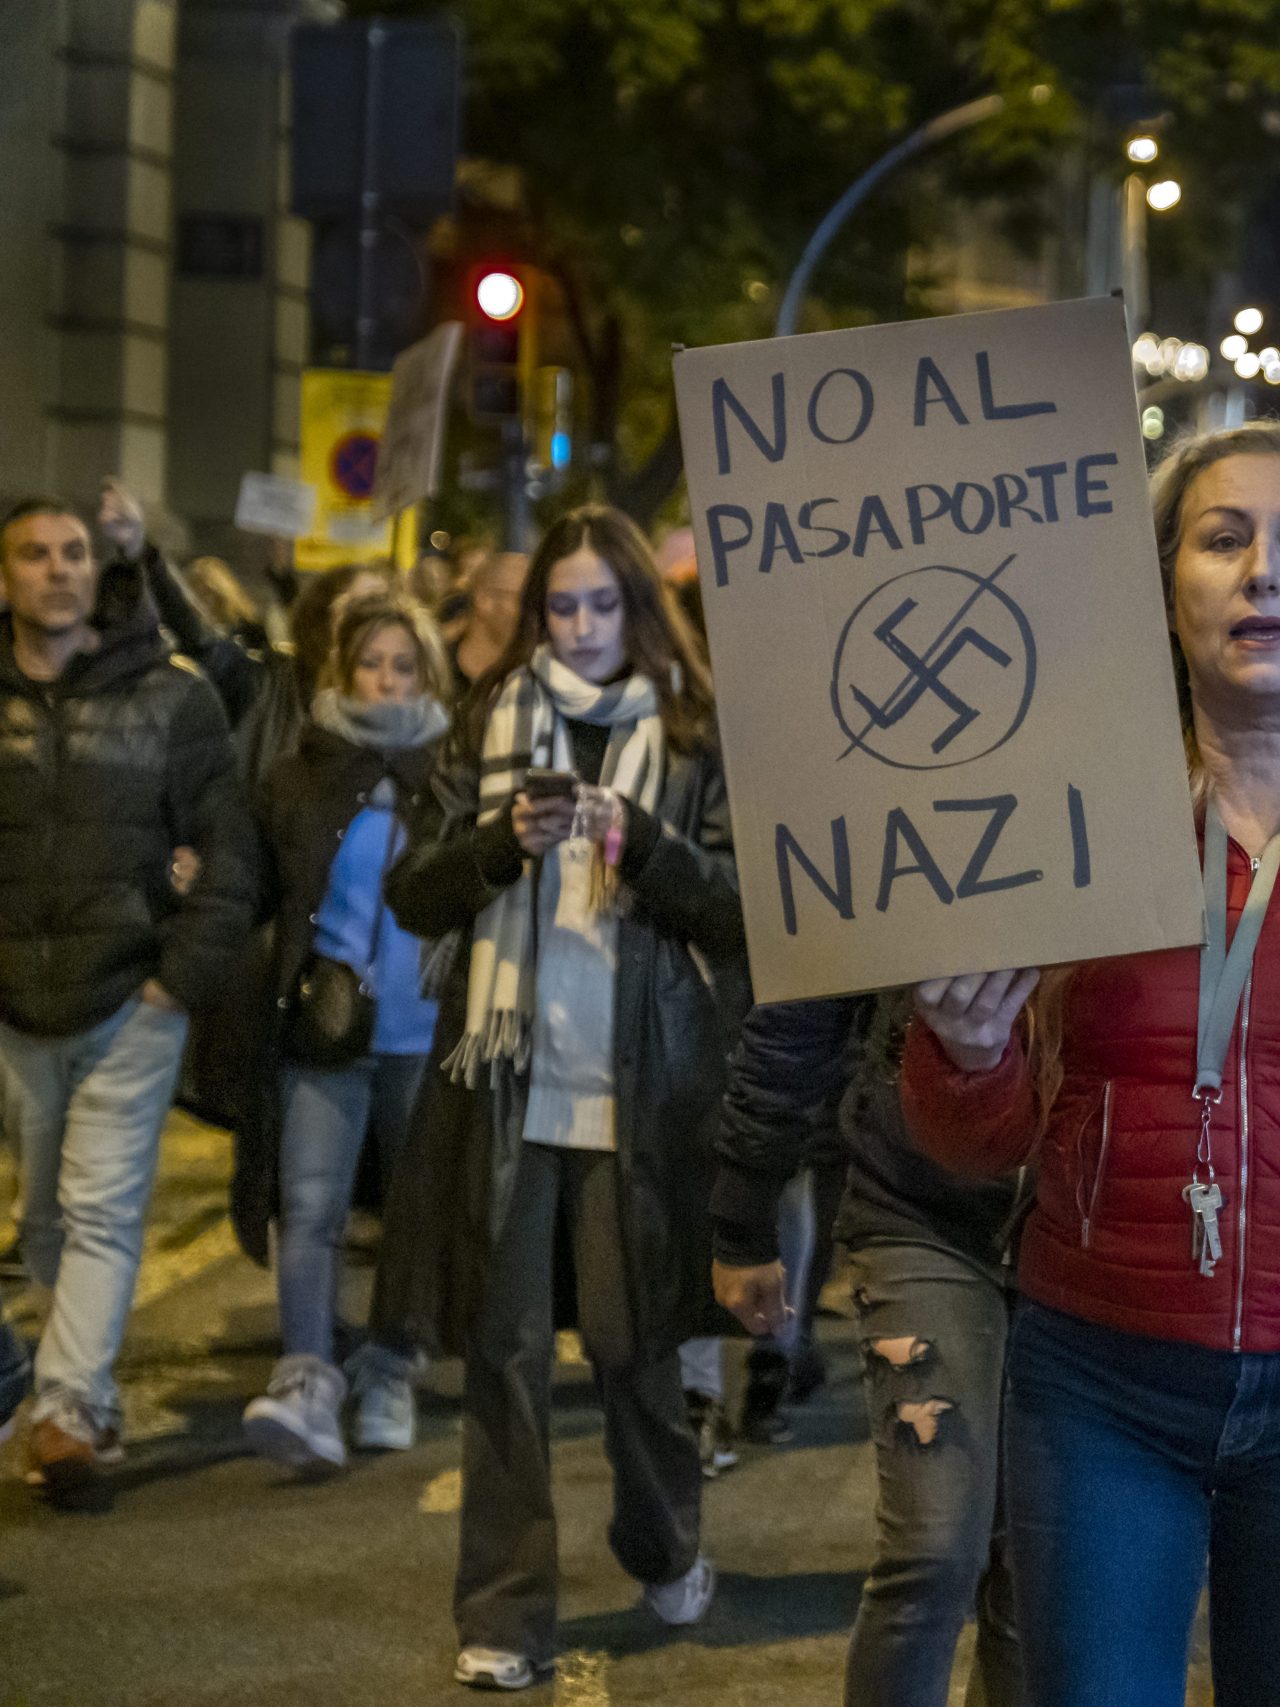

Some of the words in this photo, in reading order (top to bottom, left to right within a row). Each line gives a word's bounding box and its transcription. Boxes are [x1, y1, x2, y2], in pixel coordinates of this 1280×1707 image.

[711, 368, 875, 475] NO
[912, 350, 1059, 427] AL
[705, 452, 1119, 587] PASAPORTE
[774, 782, 1092, 936] NAZI
